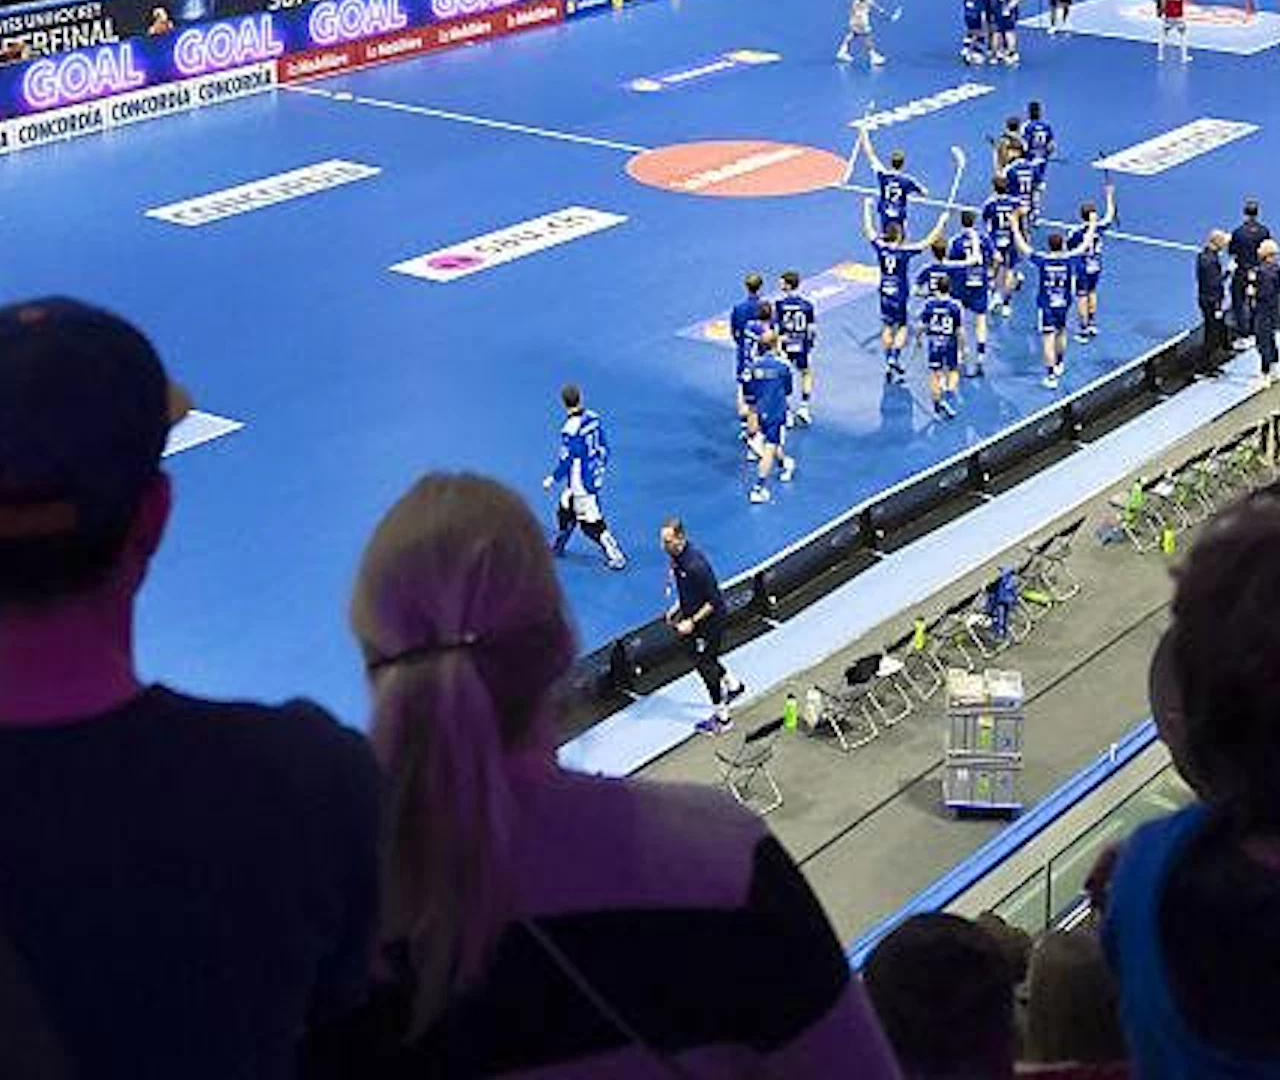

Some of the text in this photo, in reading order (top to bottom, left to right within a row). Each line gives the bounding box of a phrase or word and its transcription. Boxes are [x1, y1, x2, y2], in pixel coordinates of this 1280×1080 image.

[173, 13, 284, 76] GOAL
[22, 43, 146, 110] GOAL
[111, 83, 191, 122] CONCORDIA
[18, 104, 103, 145] CONCORDIA
